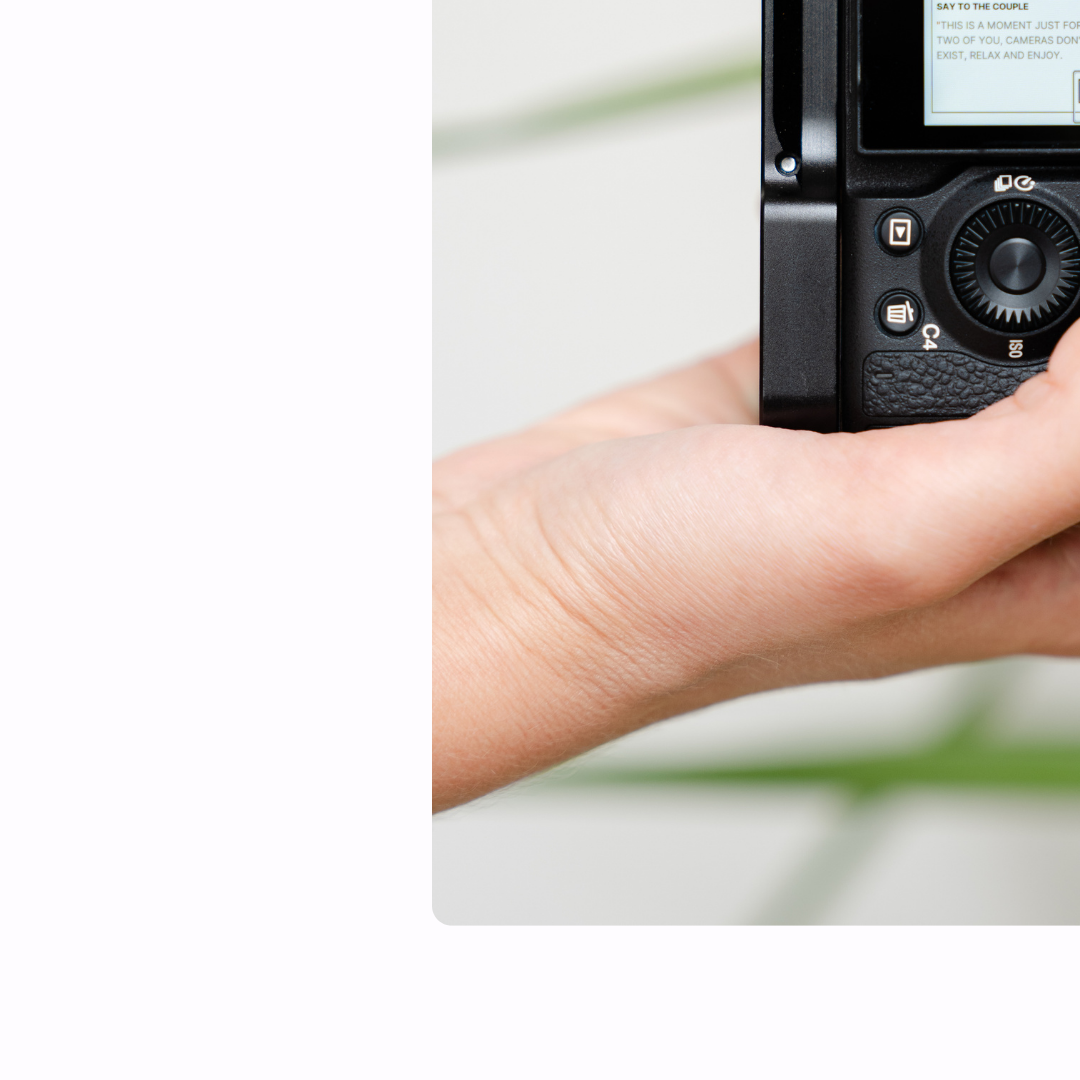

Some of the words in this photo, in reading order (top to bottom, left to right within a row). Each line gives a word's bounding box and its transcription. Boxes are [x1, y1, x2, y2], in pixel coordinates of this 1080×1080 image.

[936, 2, 956, 11] SAY
[957, 2, 971, 11] TO
[972, 2, 991, 11] THE
[992, 2, 1029, 11] COUPLE
[965, 20, 976, 30] IS
[977, 21, 985, 30] A
[987, 20, 1033, 30] MOMENT
[1034, 20, 1061, 30] JUST
[936, 35, 961, 45] TWO
[962, 35, 976, 45] OF
[978, 35, 1003, 46] YOU,
[1005, 35, 1054, 45] CAMERAS
[936, 50, 967, 62] EXIST,
[969, 50, 1001, 60] RELAX
[1003, 50, 1025, 60] AND
[1027, 50, 1063, 60] ENJOY.
[921, 323, 941, 351] C4
[1008, 339, 1024, 359] ISO
